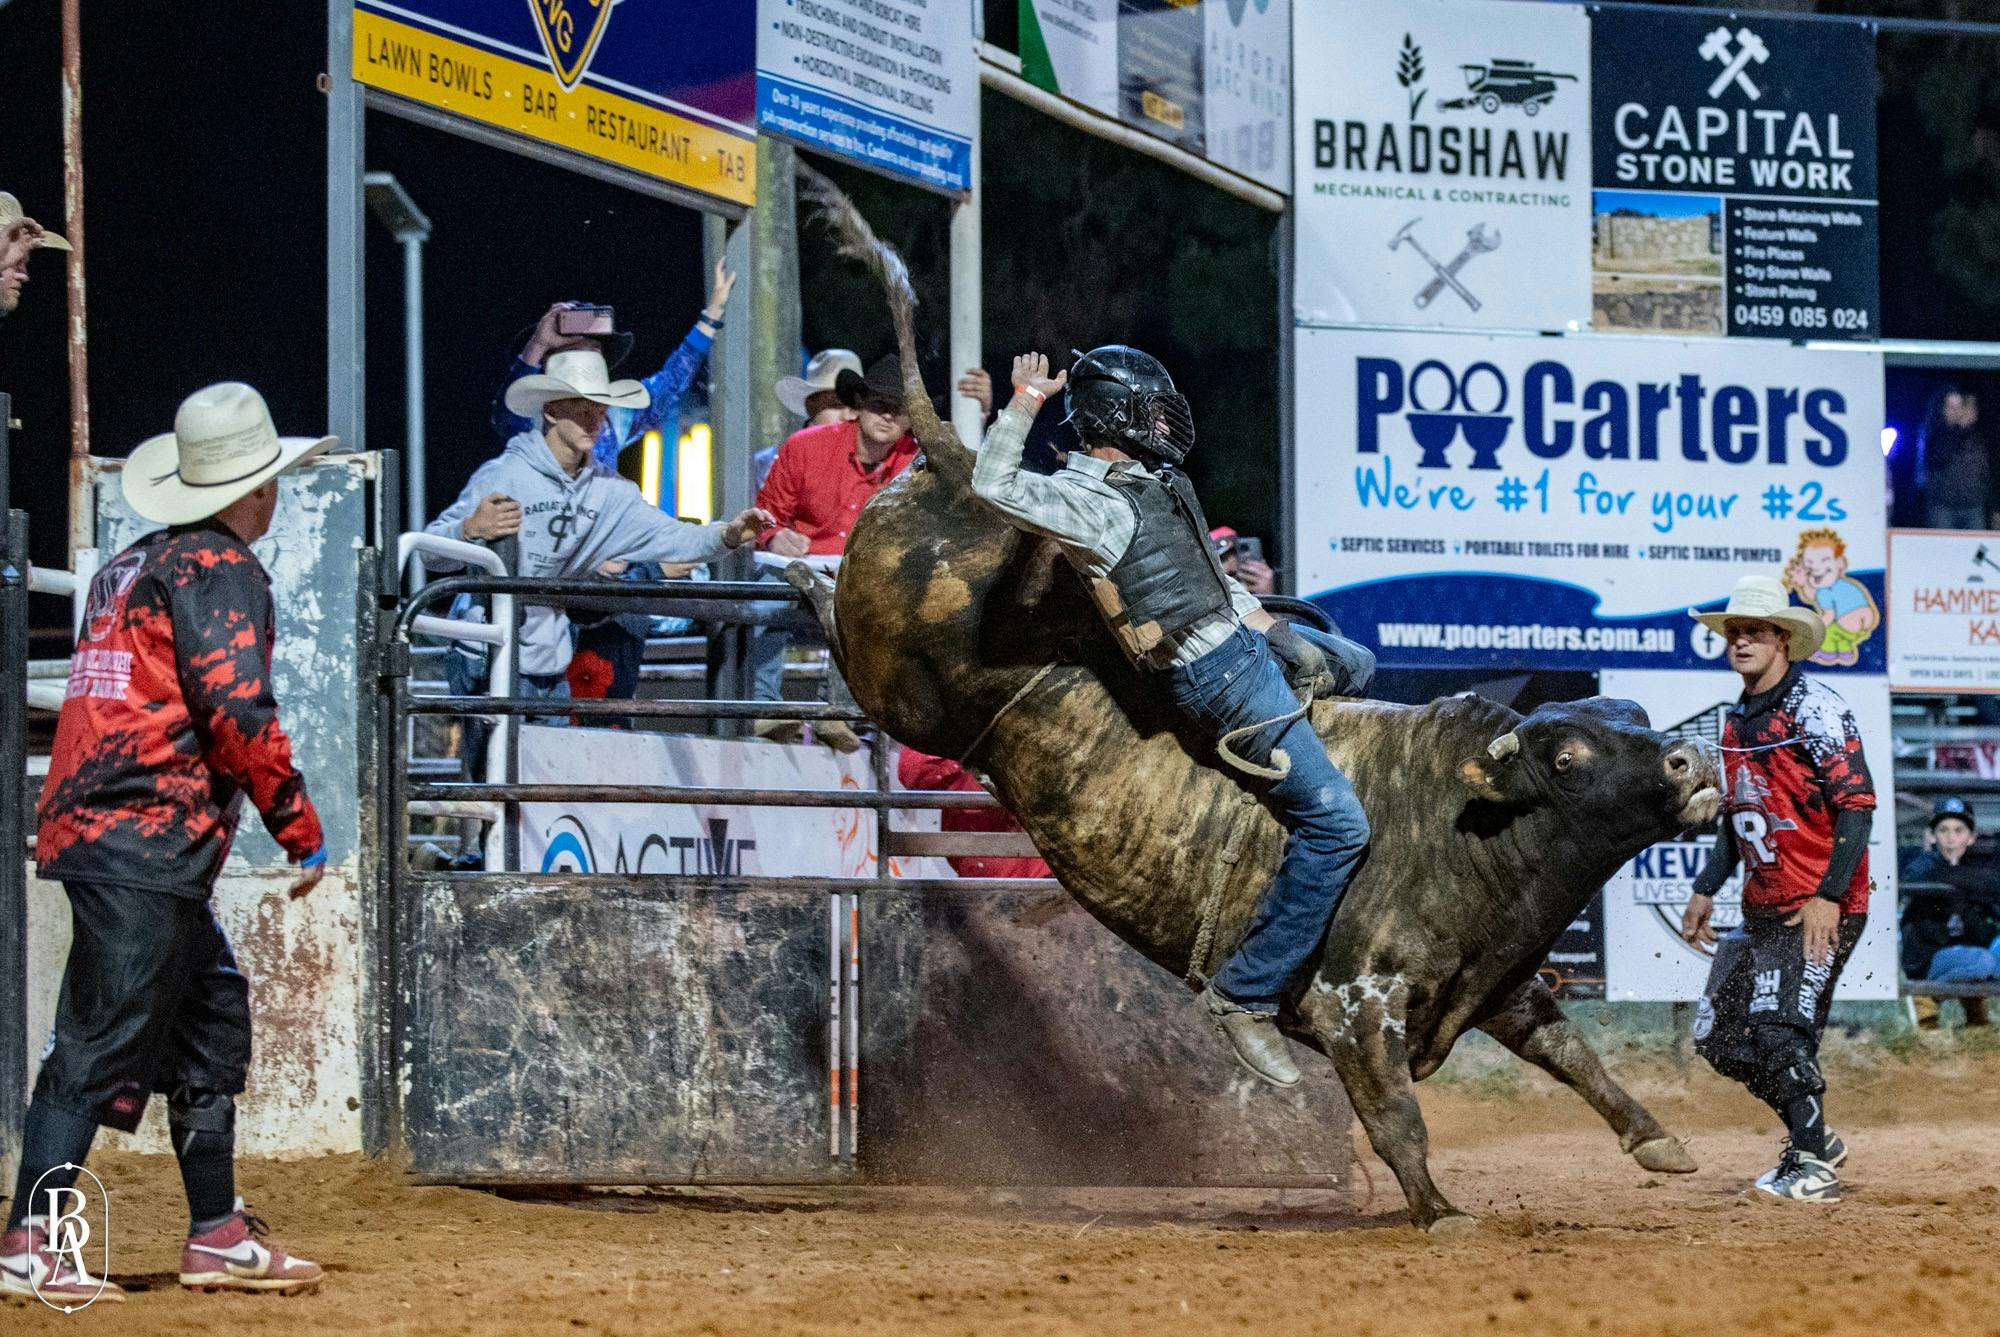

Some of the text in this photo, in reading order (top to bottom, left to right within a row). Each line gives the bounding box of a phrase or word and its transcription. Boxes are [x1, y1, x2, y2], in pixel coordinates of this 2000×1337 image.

[367, 32, 746, 183] LAWN BOWLS BAR RESTAURANT TAB
[1613, 102, 1855, 159] CAPITAL
[1313, 118, 1569, 181] BRADSHAW
[1616, 153, 1853, 191] STONE WORK
[1313, 182, 1572, 208] MECHANICAL & CONTRACTING
[1743, 206, 1863, 228] Stone Retaining Walls
[1743, 225, 1818, 244] Feature Walls
[1743, 244, 1805, 261] Fire Places
[1743, 263, 1832, 283] Dry Stone Walls
[1744, 282, 1818, 303] Stone Paving
[1734, 304, 1869, 329] 0459 085 024
[1355, 454, 1849, 534] We're #1 for your #2s
[1341, 537, 1783, 563] SEPTIC SERVICES PORTABLE TOILETS FOR HIRE SEPTIC TANKS PUMPED
[1377, 622, 1676, 653] www.poocarters.com.au
[1732, 809, 1777, 864] R
